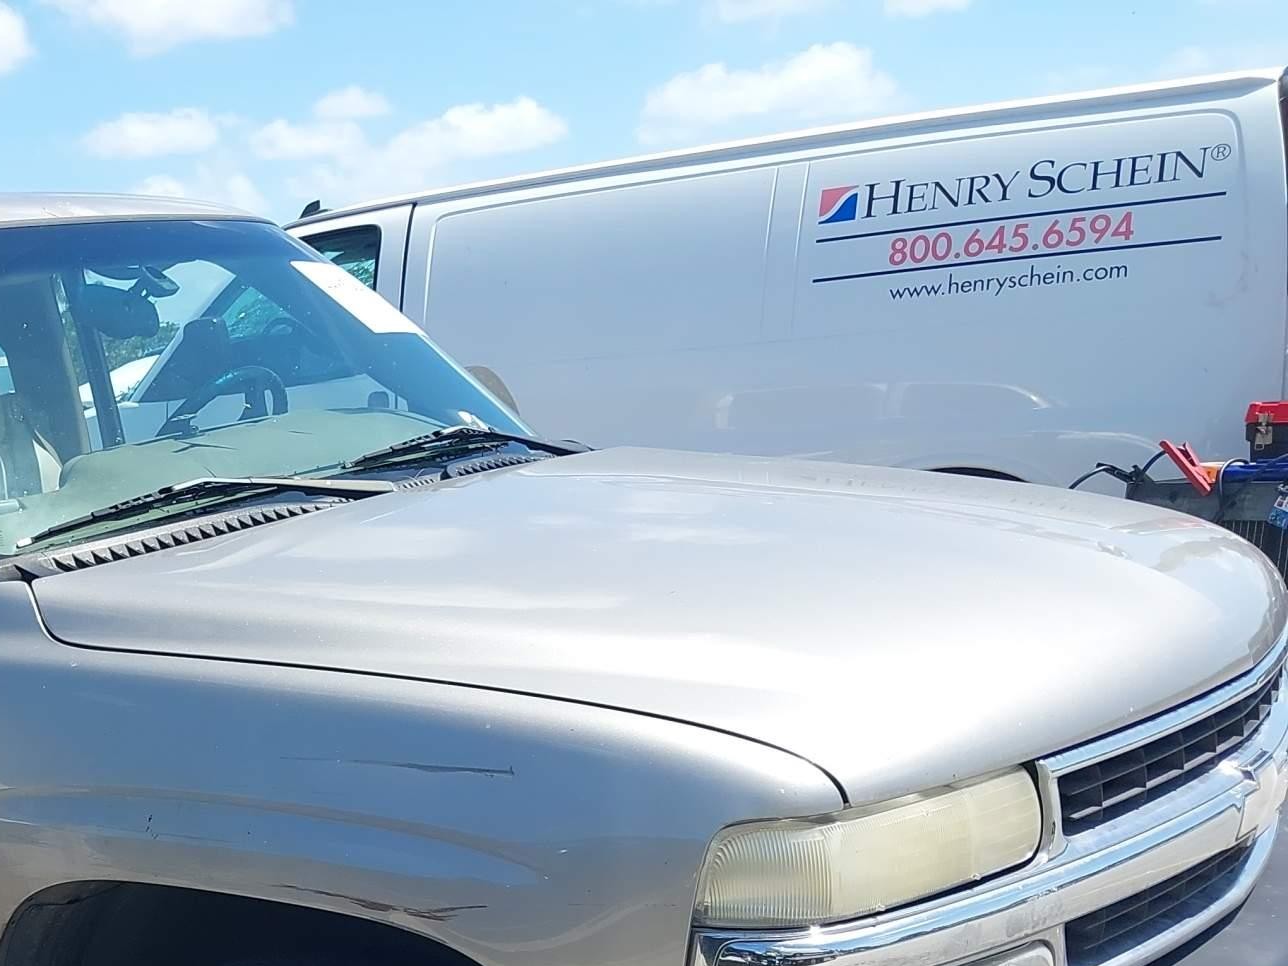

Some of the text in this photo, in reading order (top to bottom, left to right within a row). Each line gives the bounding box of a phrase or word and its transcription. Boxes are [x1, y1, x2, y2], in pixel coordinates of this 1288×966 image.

[861, 170, 1021, 220] HENRY
[888, 211, 1135, 267] 800.645.6594
[889, 263, 1129, 300] www.henryschein.com
